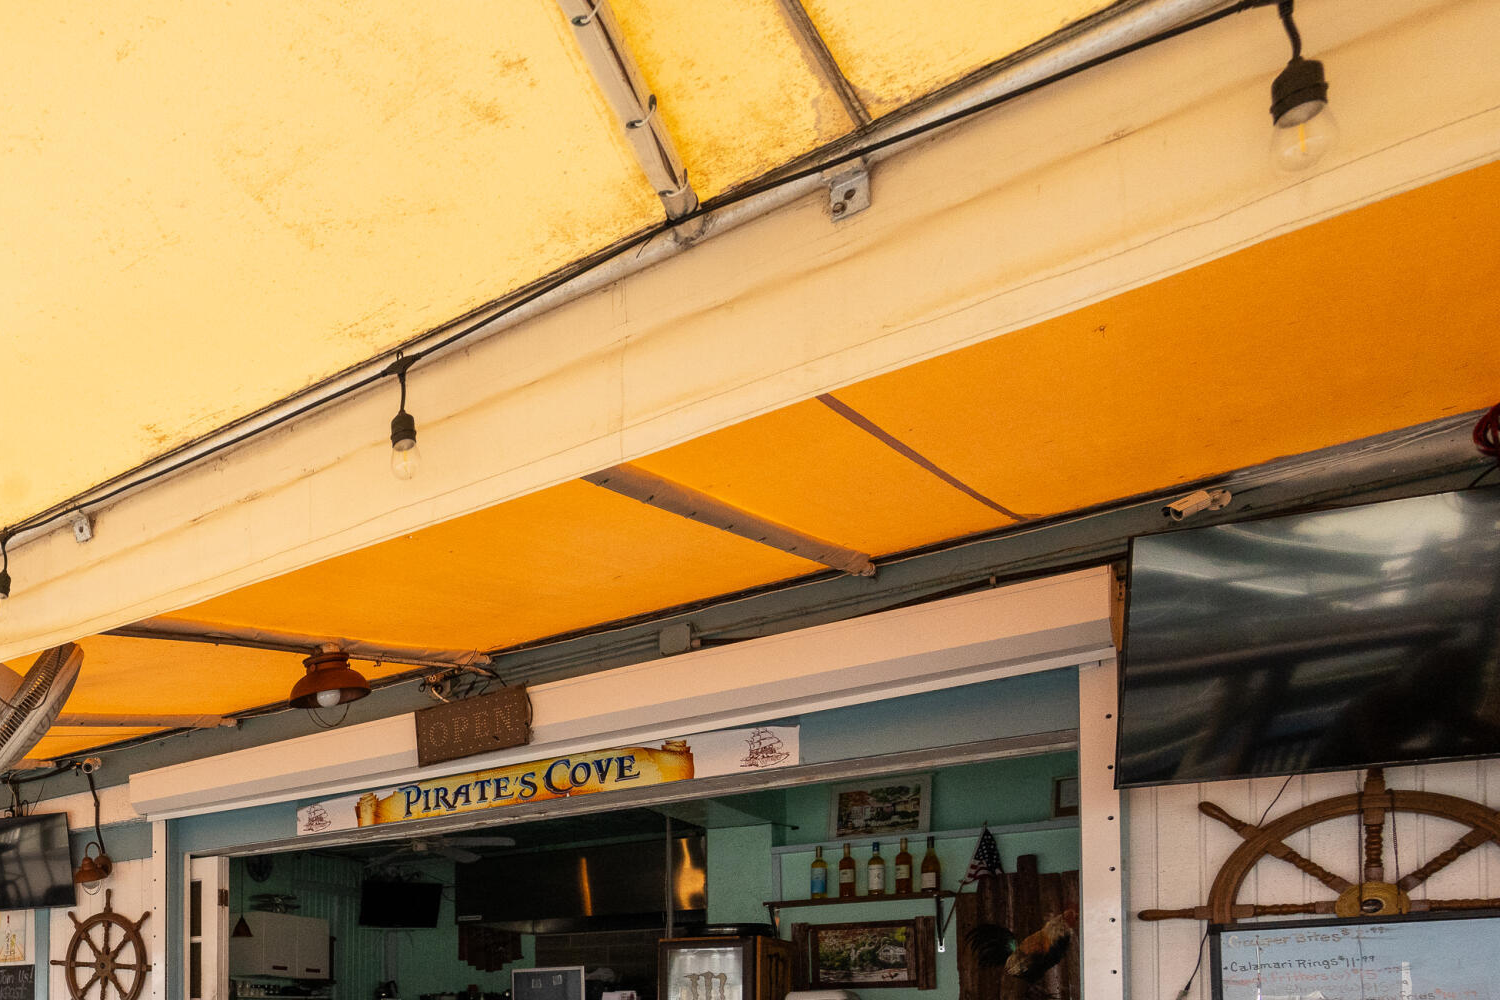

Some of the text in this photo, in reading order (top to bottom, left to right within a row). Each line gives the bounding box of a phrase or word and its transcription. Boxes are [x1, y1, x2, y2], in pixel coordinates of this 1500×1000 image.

[429, 704, 513, 747] OPEN
[399, 754, 641, 819] PIRATE'S COVE
[1230, 960, 1293, 973] Calamari
[1295, 958, 1339, 971] Rings
